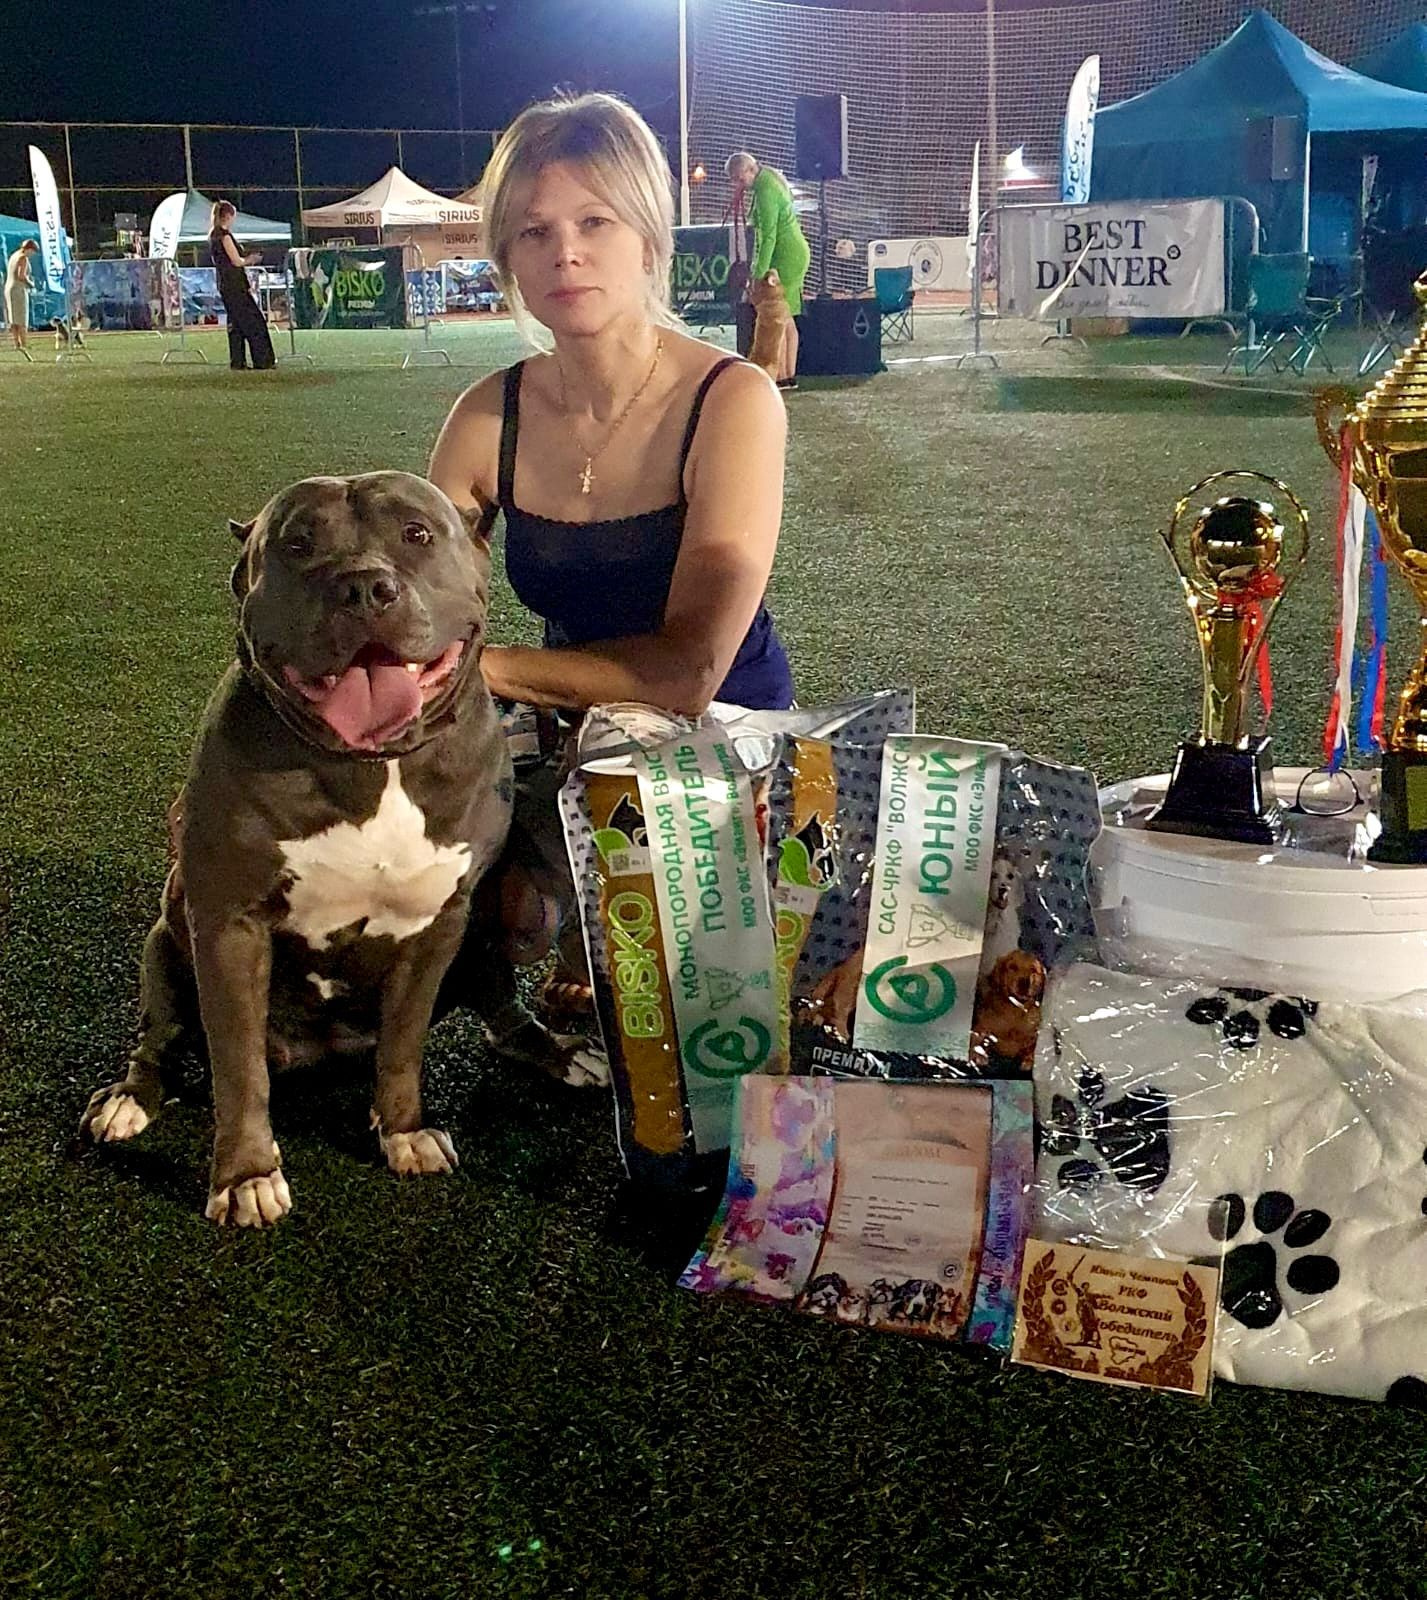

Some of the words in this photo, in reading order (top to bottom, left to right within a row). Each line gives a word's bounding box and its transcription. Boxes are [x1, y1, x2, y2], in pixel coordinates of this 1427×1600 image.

[344, 212, 375, 225] SIRIUS
[439, 209, 480, 222] SIRIUS
[445, 233, 478, 245] SIRIUS
[1064, 219, 1146, 253] BEST
[336, 270, 385, 297] BISKO
[673, 254, 729, 287] ISKO
[1035, 256, 1172, 290] DINNER
[918, 750, 961, 896] ЮНЫЙ
[967, 803, 984, 833] ФКС
[674, 745, 726, 932] ПОБЕДИТЕЛЬ
[964, 833, 980, 872] МОО
[656, 803, 700, 1000] МОНОПОРОДНАЯ
[607, 890, 665, 1038] BISKO
